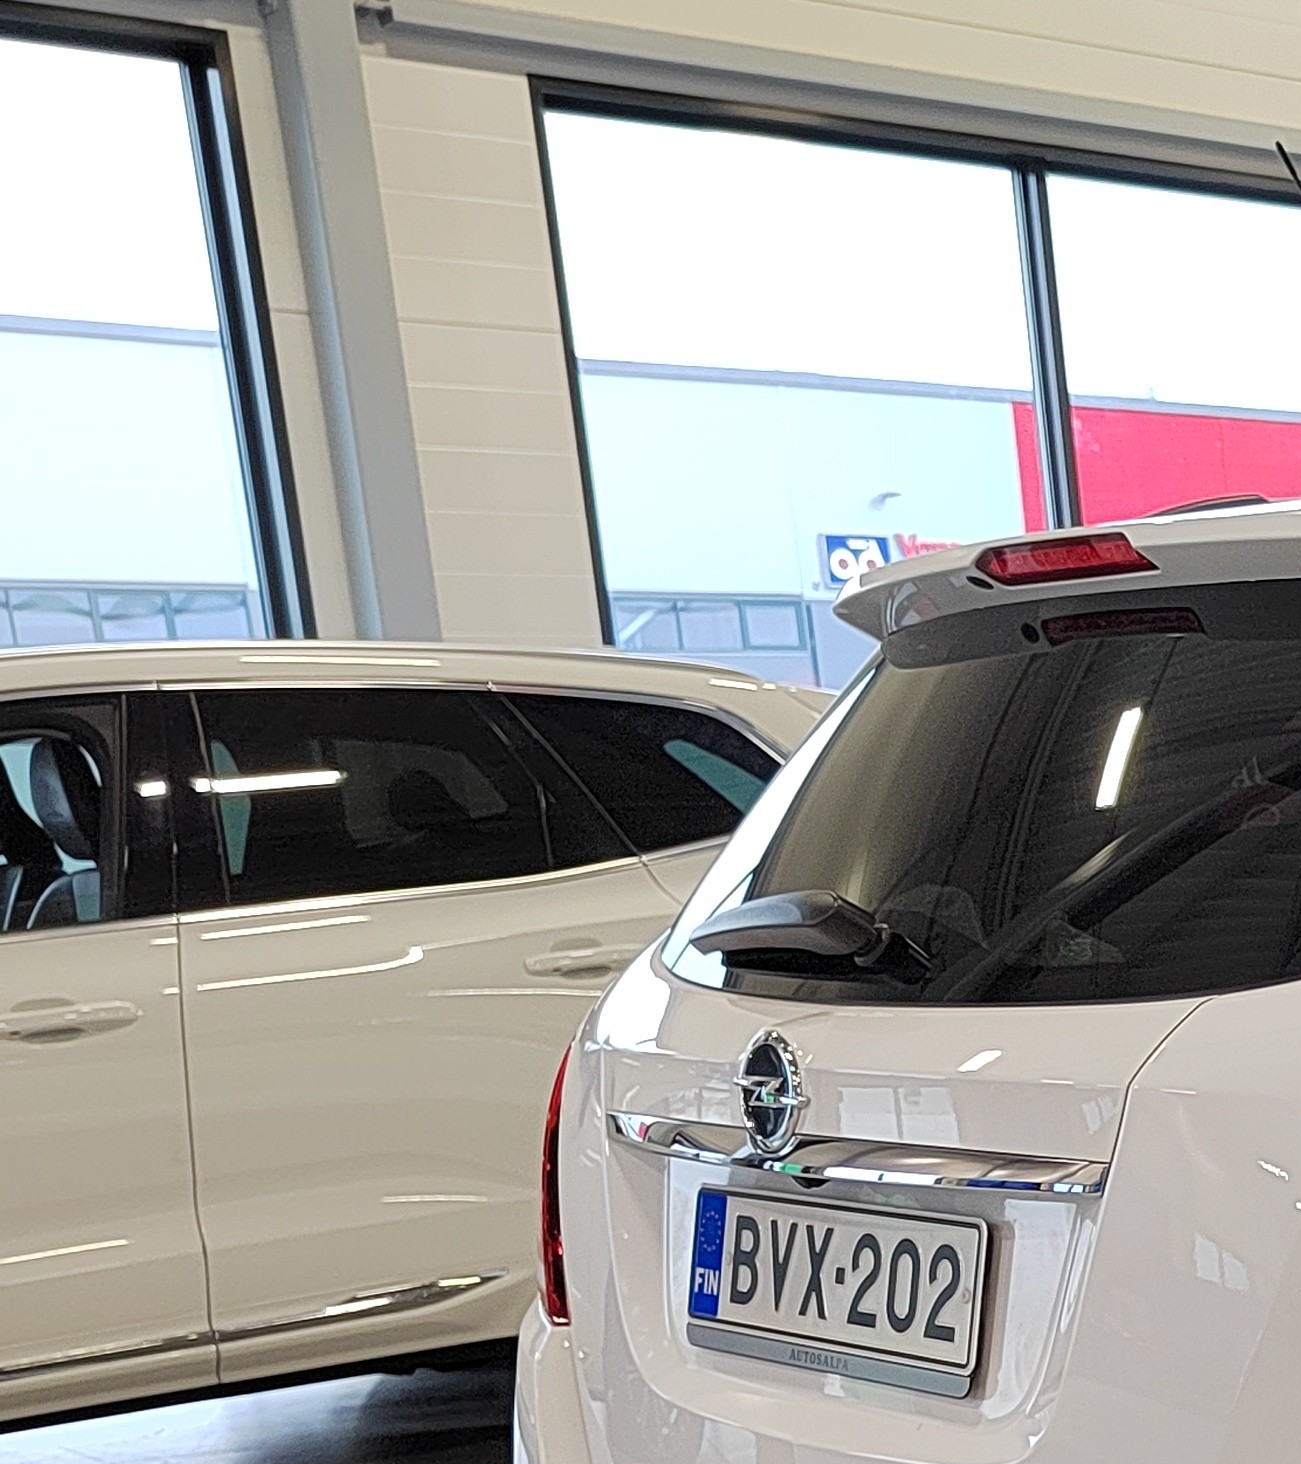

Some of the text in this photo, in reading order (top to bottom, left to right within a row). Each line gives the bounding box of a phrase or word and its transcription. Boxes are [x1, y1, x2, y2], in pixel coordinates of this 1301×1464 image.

[693, 1267, 720, 1296] FIN
[729, 1215, 961, 1343] BVX-202
[788, 1348, 850, 1372] AUTOSALPA
